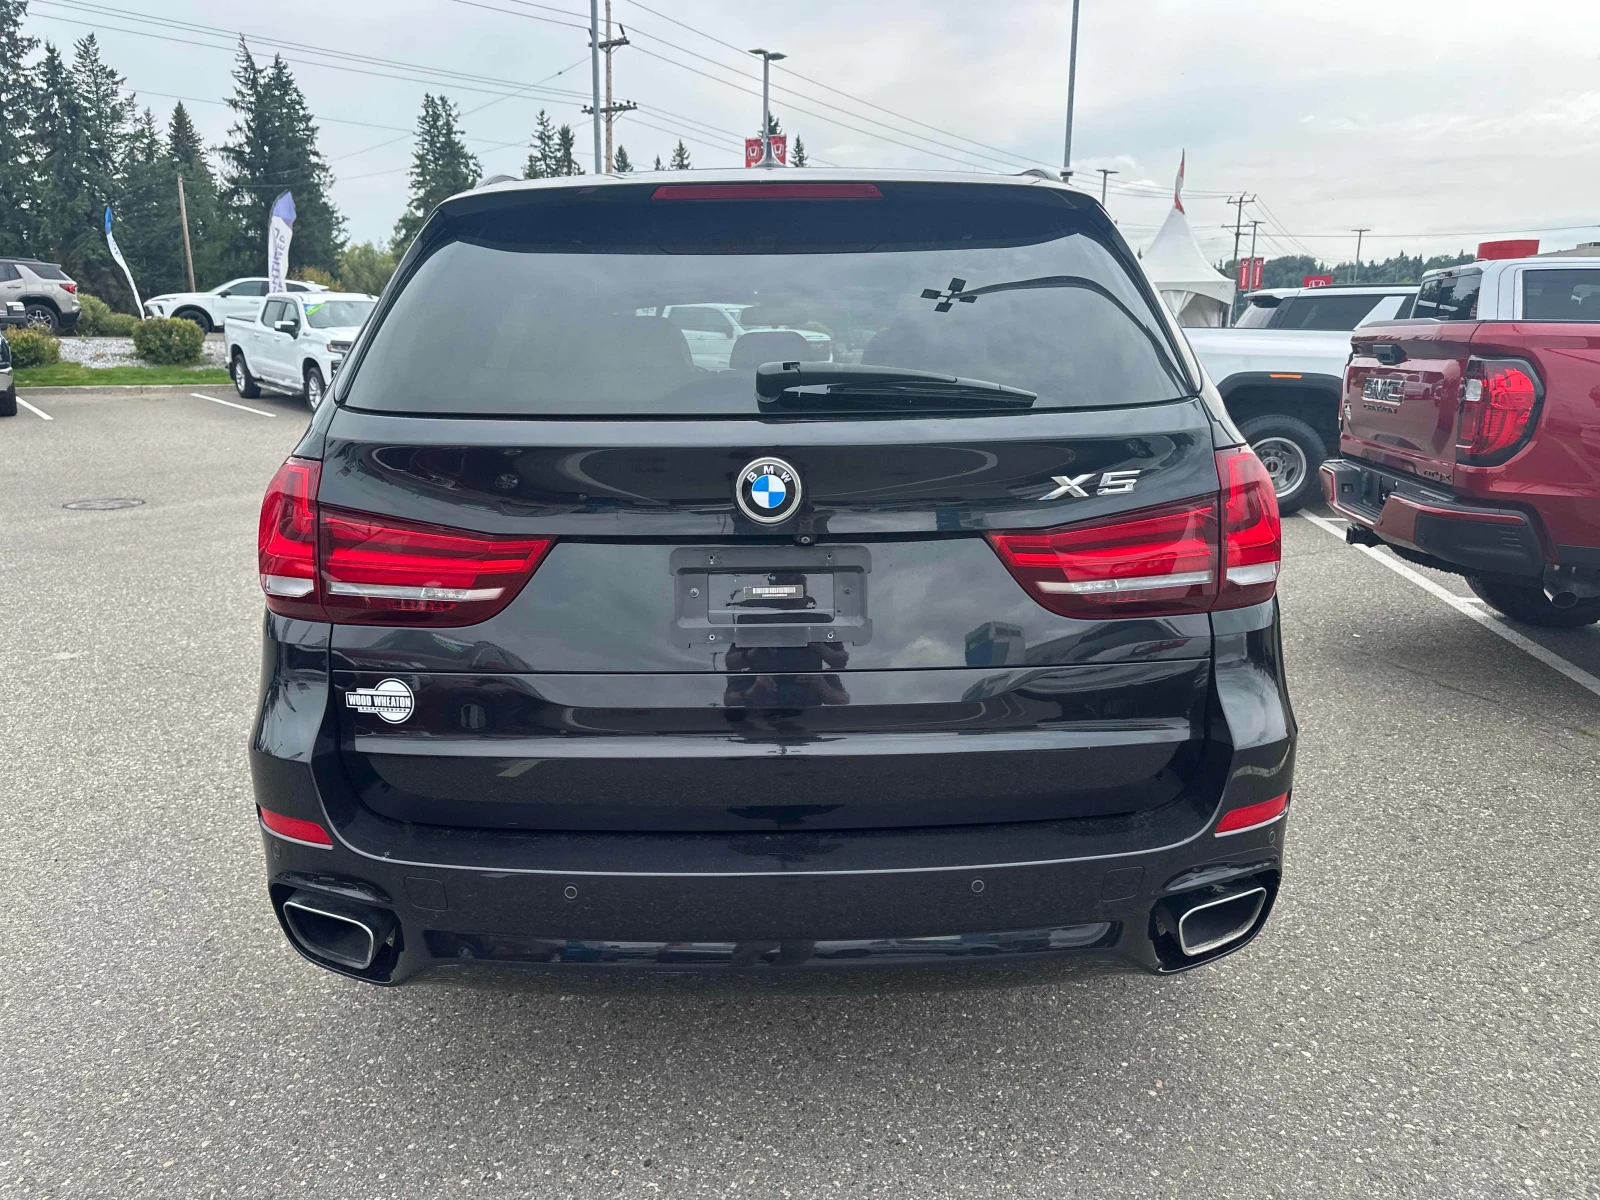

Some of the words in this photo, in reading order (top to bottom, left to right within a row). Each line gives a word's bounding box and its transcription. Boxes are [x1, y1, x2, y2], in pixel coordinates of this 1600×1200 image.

[1362, 377, 1404, 404] GMC
[746, 465, 792, 483] BMW
[1038, 469, 1141, 500] X5
[347, 694, 372, 706] WOOD
[373, 695, 411, 708] WHEATON
